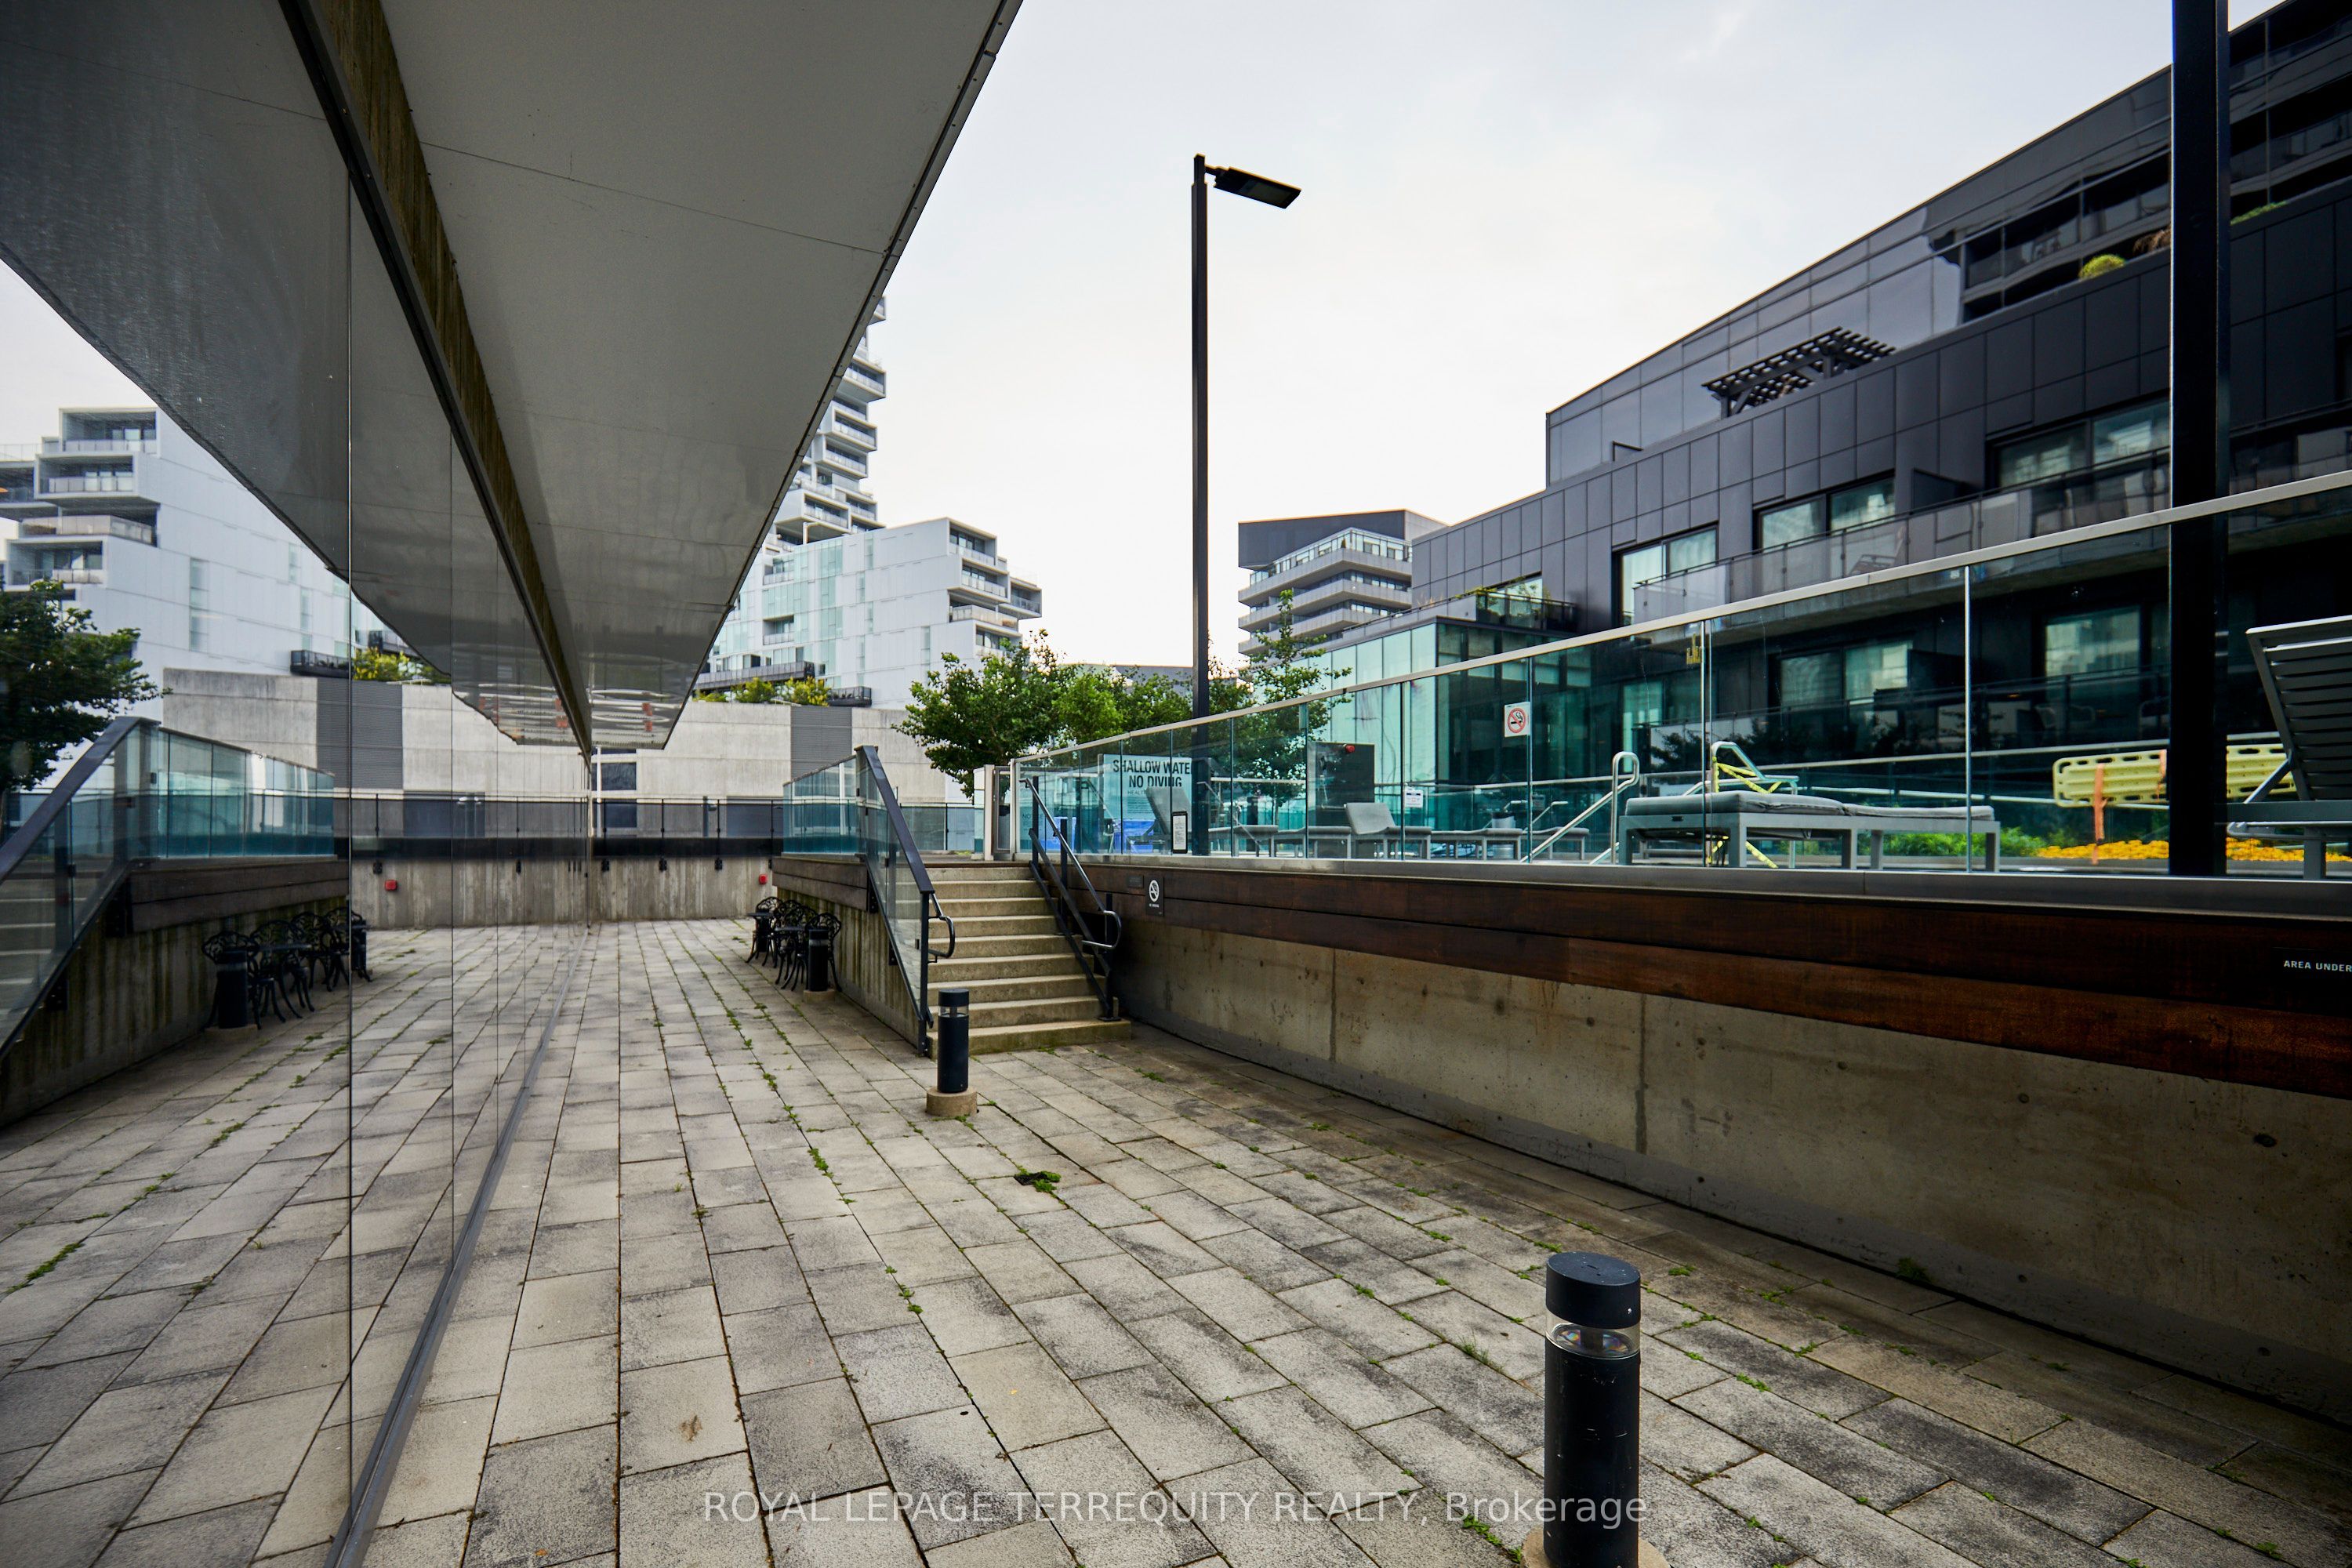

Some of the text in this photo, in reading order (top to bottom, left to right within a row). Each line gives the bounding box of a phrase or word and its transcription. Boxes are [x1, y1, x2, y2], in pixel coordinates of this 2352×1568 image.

[1112, 759, 1192, 775] SHALLOW WATE
[1129, 775, 1183, 789] NO DIVING
[2284, 960, 2352, 972] AREA UNDER
